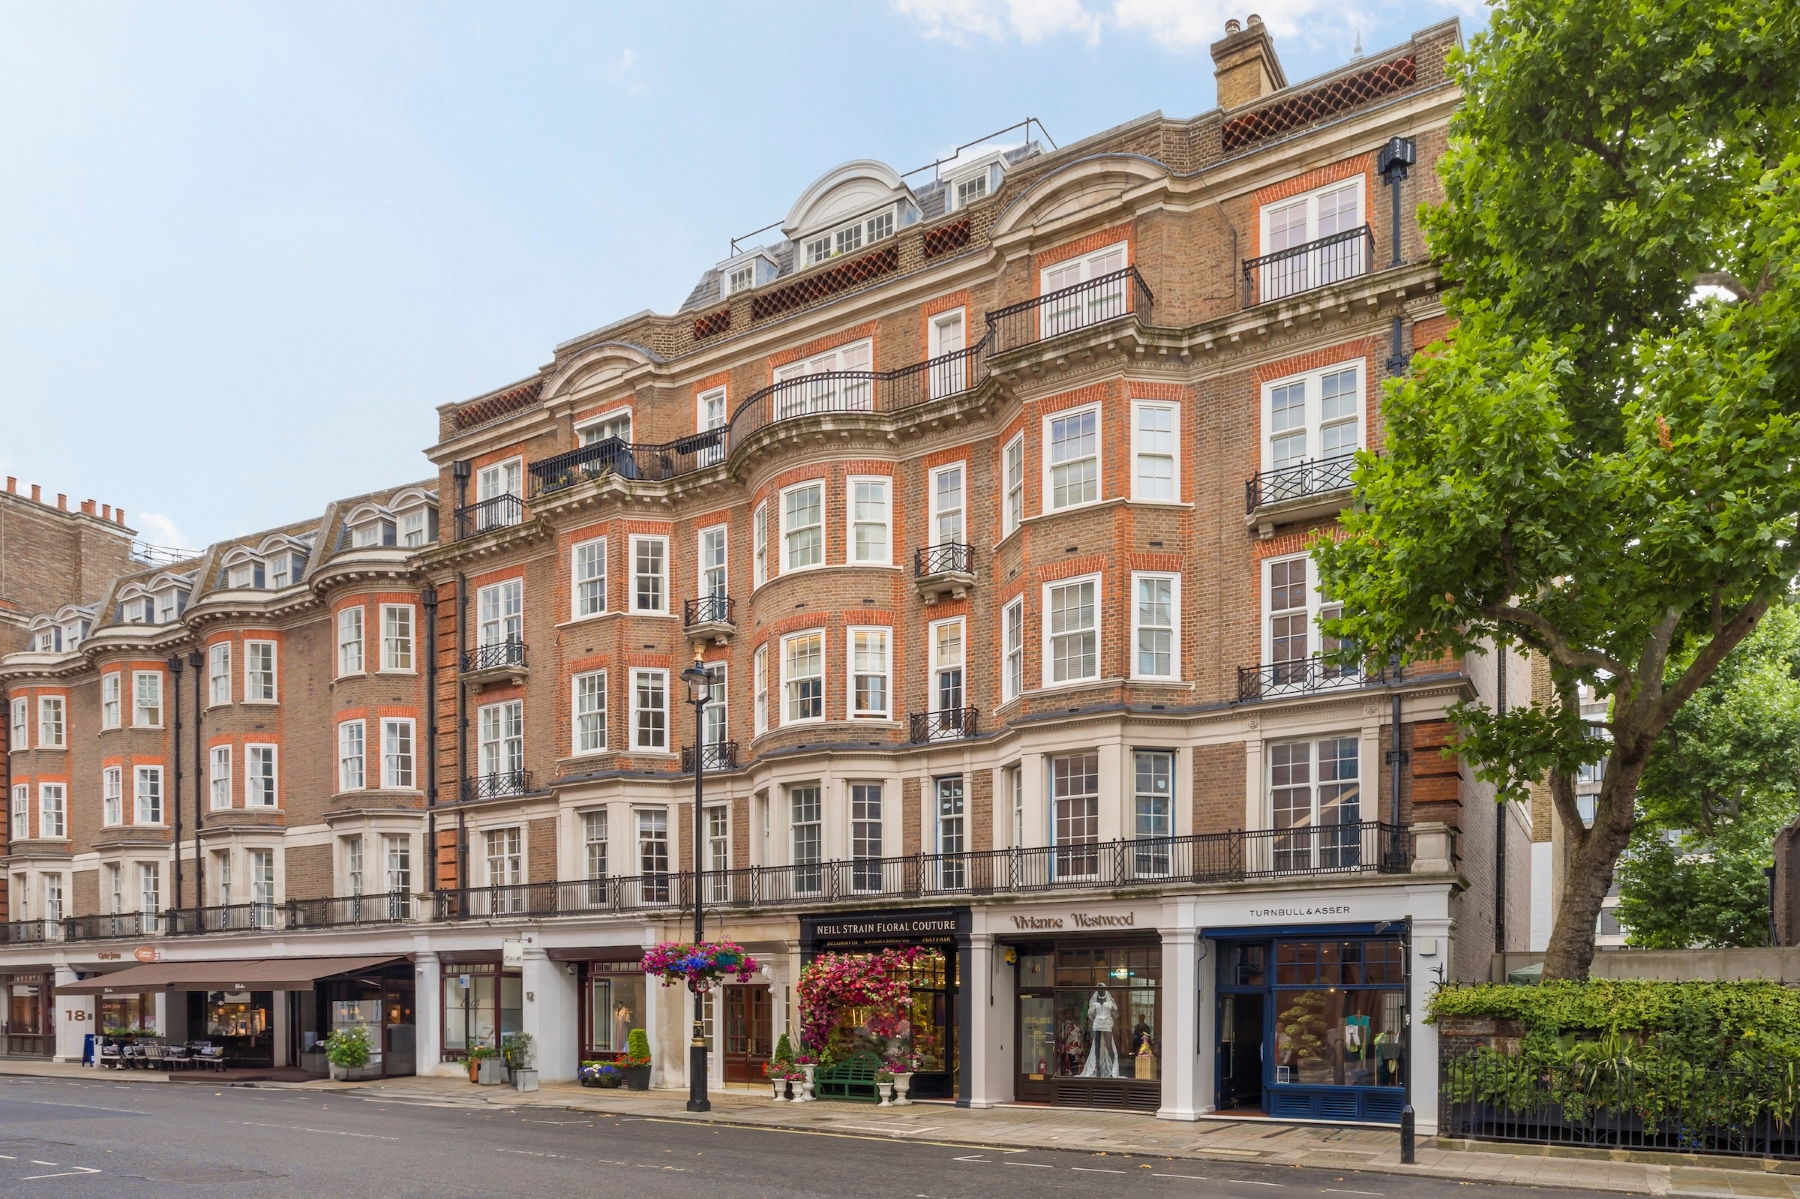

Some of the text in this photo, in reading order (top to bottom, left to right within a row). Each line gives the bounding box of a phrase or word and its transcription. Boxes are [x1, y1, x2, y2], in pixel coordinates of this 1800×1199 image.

[1249, 908, 1304, 917] TURNBULL
[1315, 906, 1350, 915] ASSER
[1010, 911, 1135, 930] Vivienne Westwood
[817, 920, 956, 935] NEILL STRAIN FLORAL COUTURE
[697, 981, 707, 989] 20
[65, 1010, 86, 1021] 18
